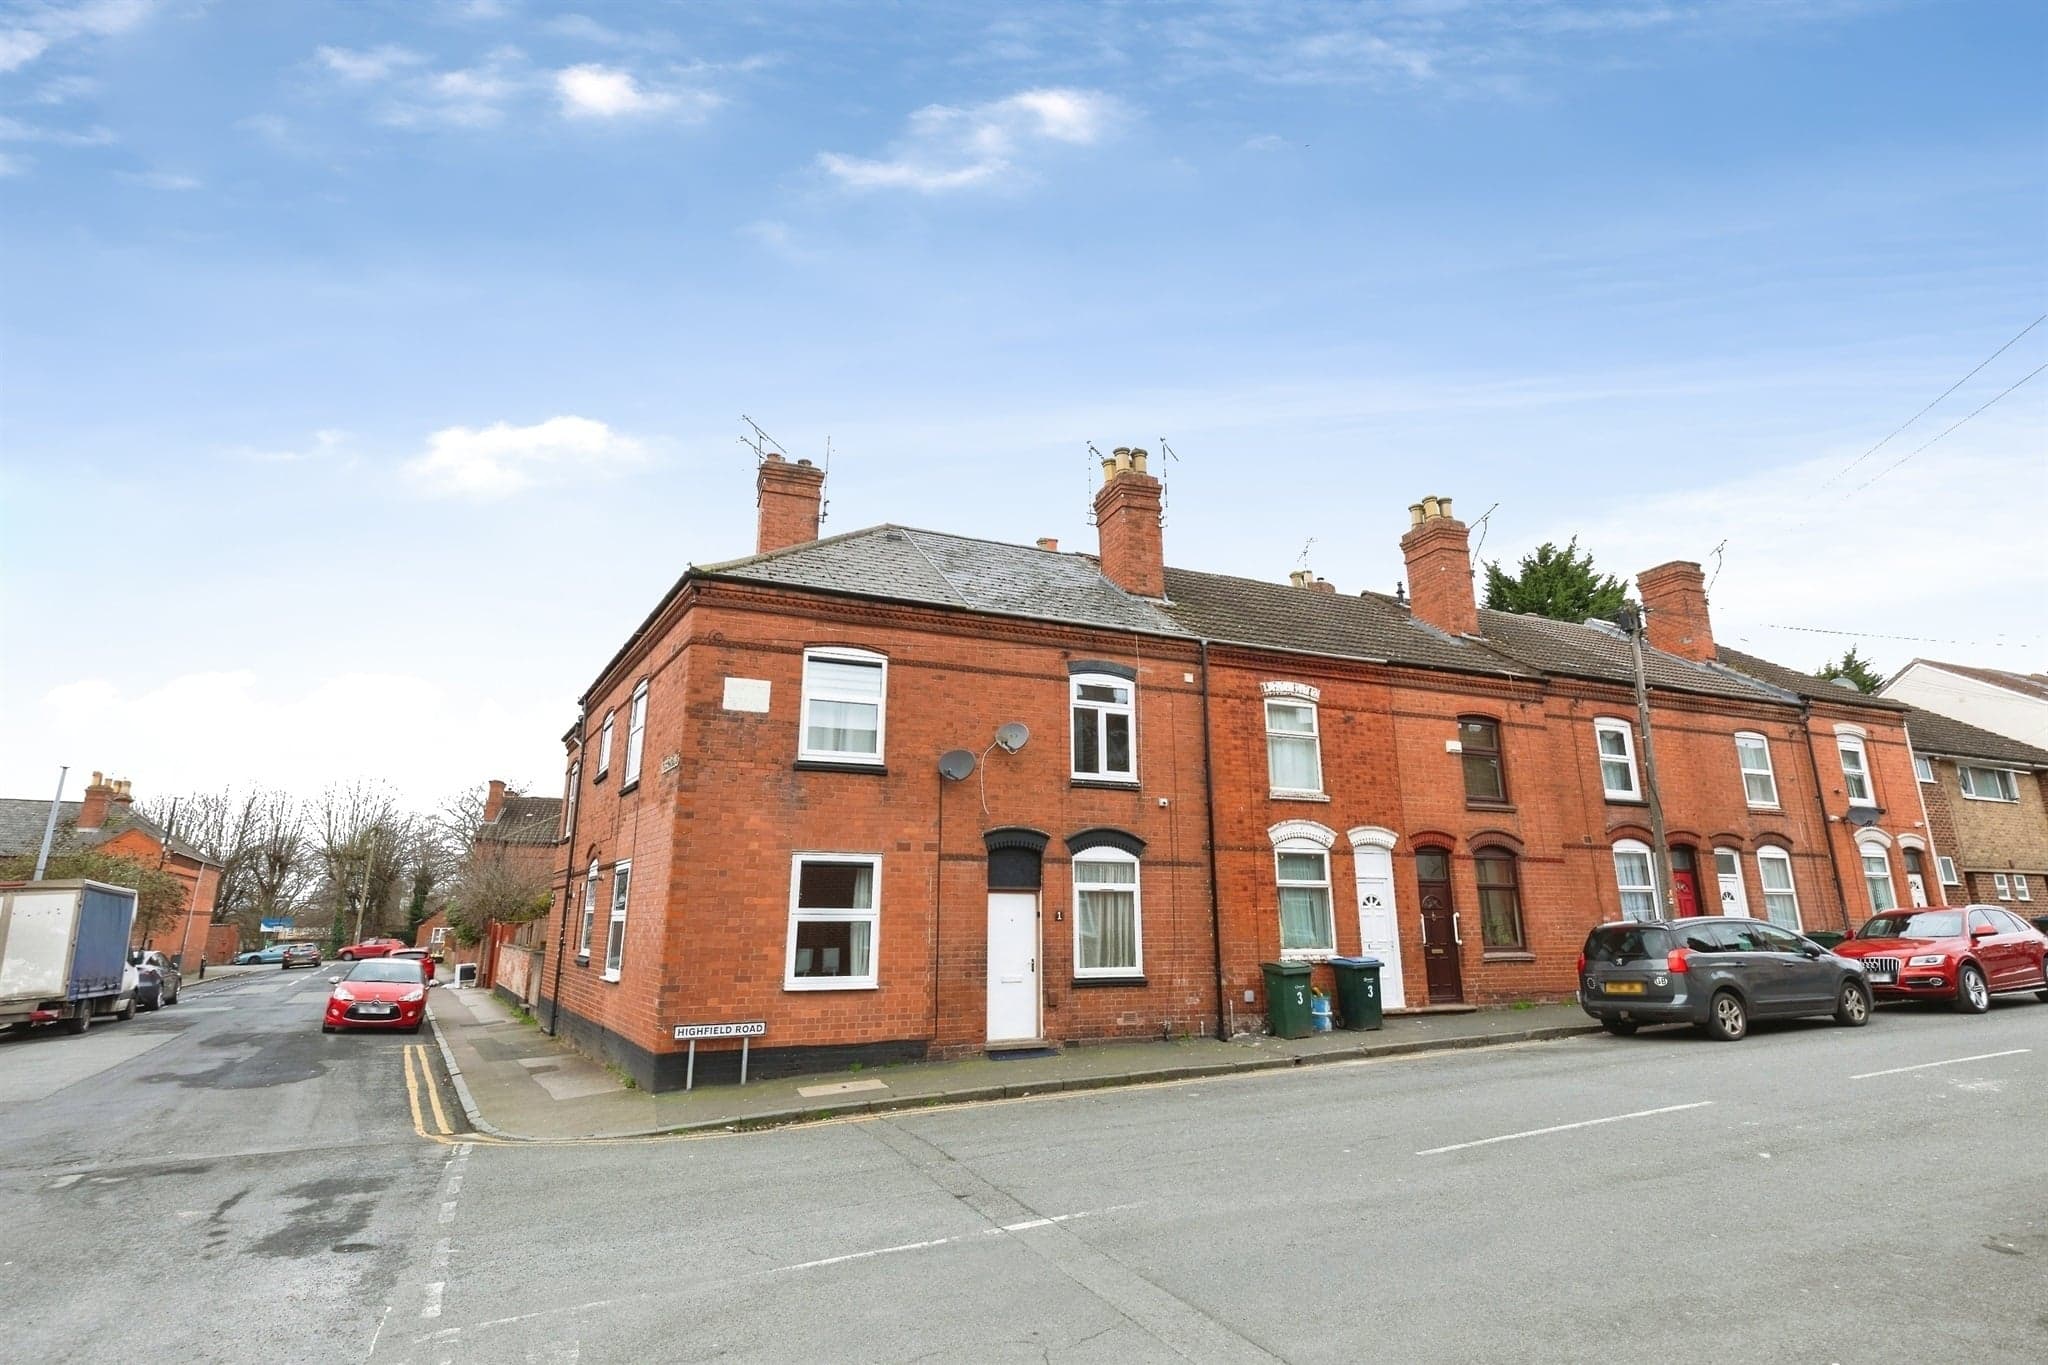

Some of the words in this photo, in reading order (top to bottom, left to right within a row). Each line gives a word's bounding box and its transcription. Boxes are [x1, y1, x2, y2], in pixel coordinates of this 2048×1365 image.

[1057, 911, 1062, 920] 1
[1367, 985, 1374, 998] 3
[1297, 992, 1304, 1005] 3
[677, 1026, 732, 1036] HIGHFIELD
[735, 1024, 763, 1033] ROAD
